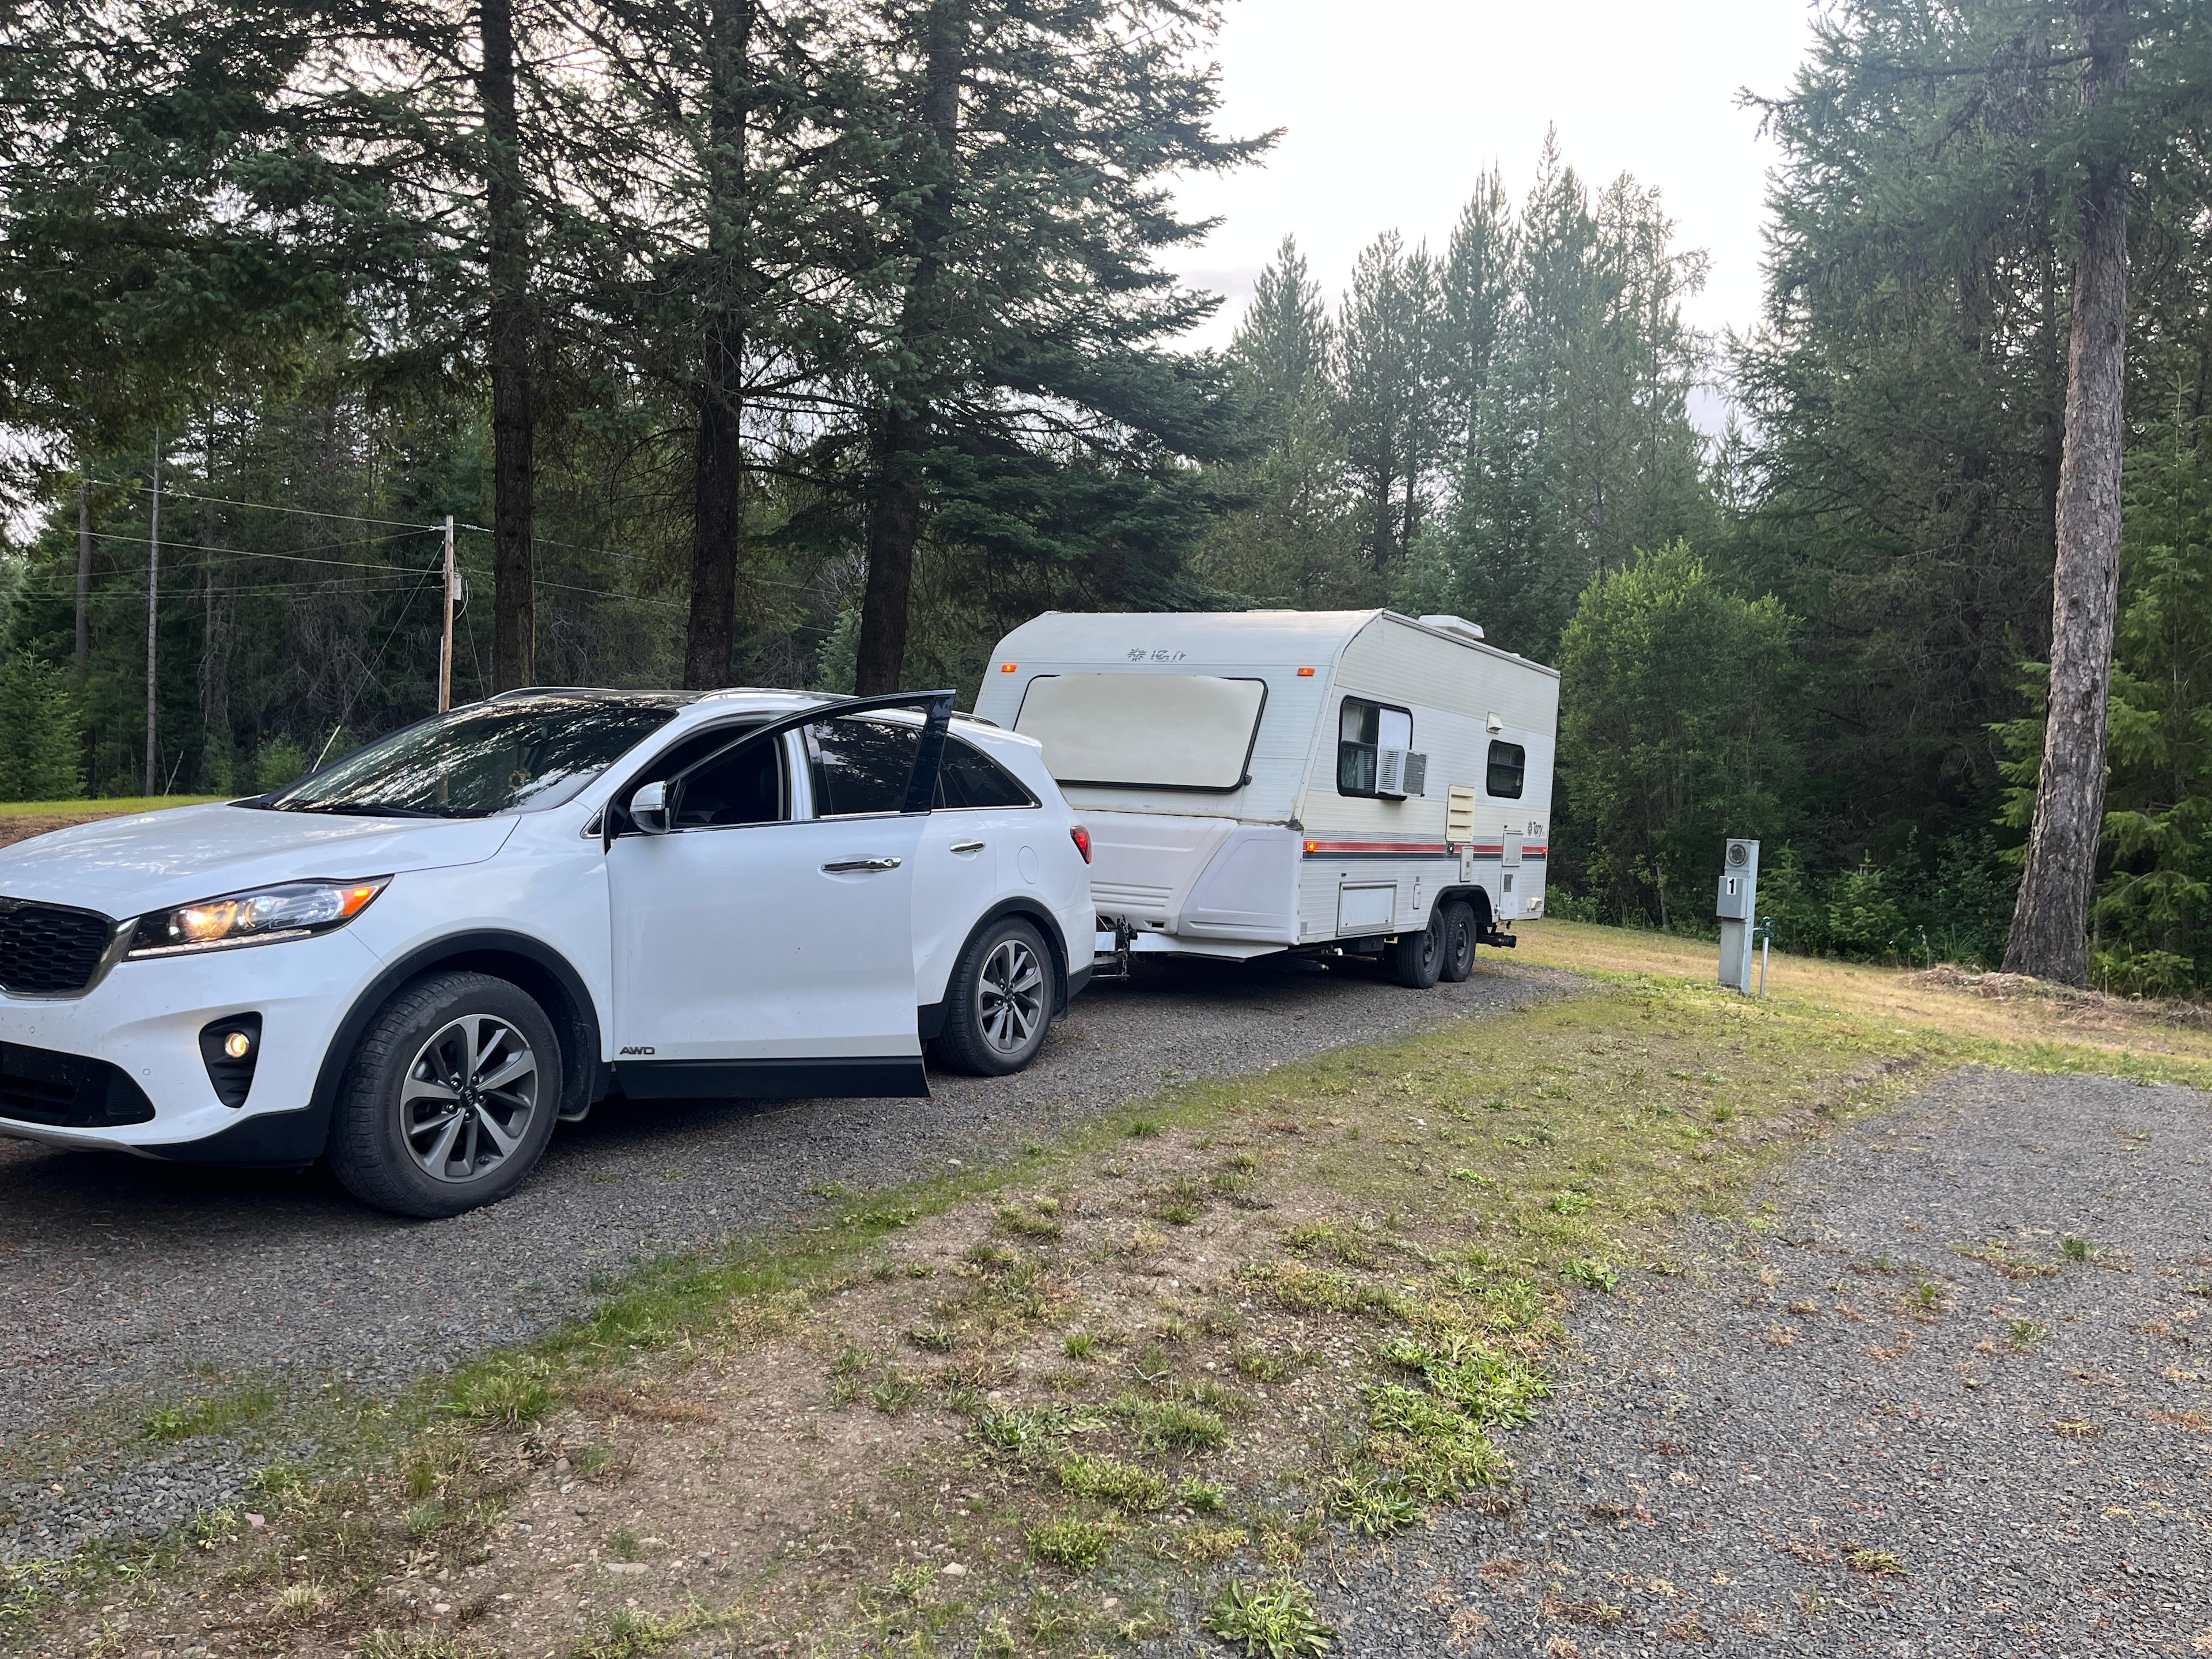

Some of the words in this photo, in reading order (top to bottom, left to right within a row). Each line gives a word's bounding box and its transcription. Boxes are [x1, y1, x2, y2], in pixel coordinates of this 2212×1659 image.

[1729, 878, 1734, 894] 1
[619, 1046, 655, 1055] AWD
[464, 1089, 474, 1106] KIA
